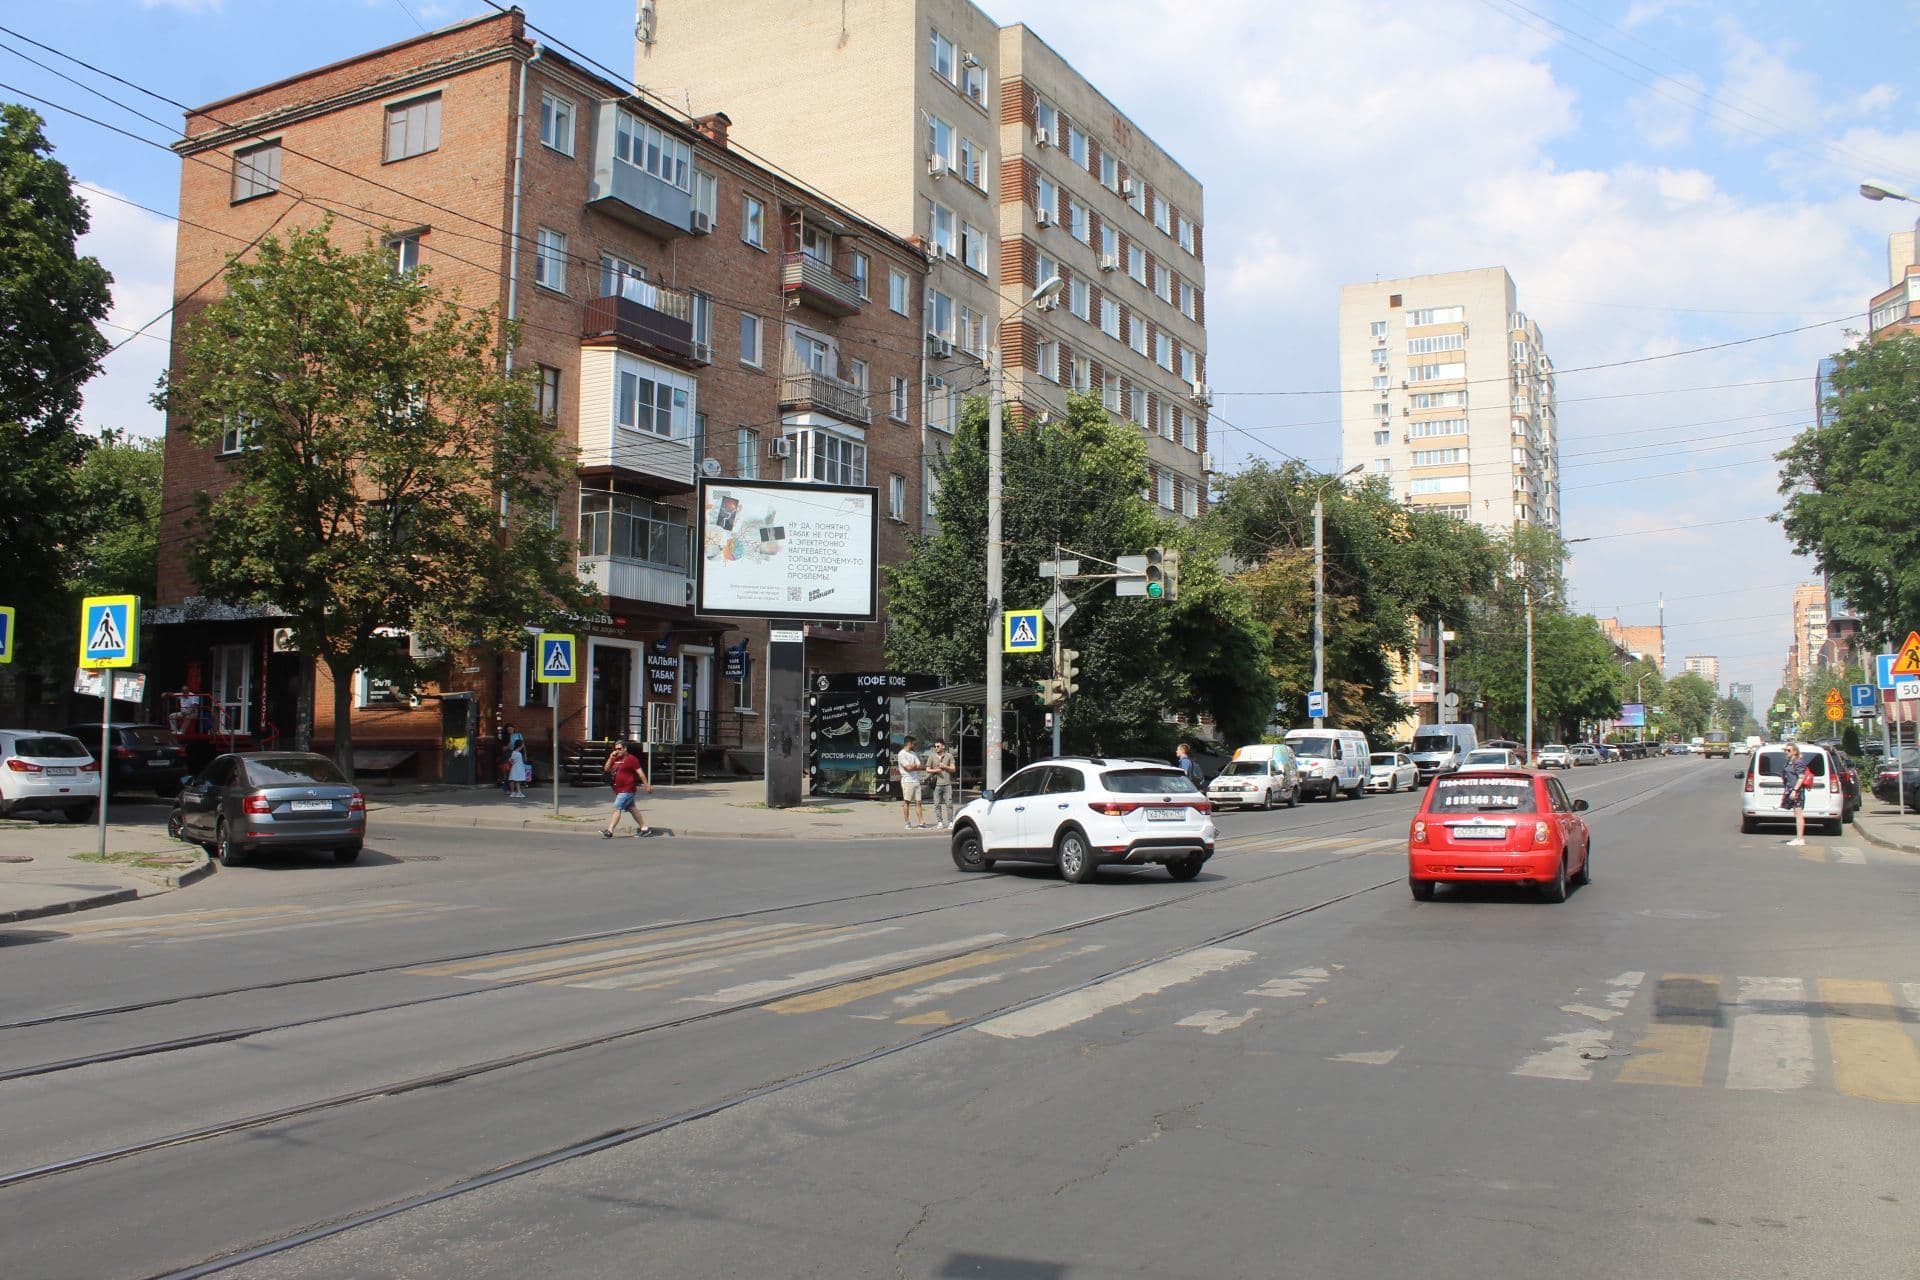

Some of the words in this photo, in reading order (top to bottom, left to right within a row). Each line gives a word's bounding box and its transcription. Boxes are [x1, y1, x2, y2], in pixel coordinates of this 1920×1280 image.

[788, 521, 797, 529] НУ
[796, 539, 845, 548] ЭЛЕКТРОННО
[787, 555, 819, 563] ТОЛЬКО
[821, 557, 864, 566] ПОЧЕМУ-ТО
[787, 563, 794, 571] С
[796, 564, 838, 572] СОСУДАМИ
[648, 655, 678, 667] КАЛЬЯН
[650, 669, 675, 680] ТАБАК
[857, 676, 886, 686] КОФЕ
[888, 676, 907, 686] КОФЕ
[653, 683, 672, 694] VAPE
[1903, 684, 1919, 695] 50
[1829, 708, 1839, 717] 40
[821, 752, 875, 760] РОСТОВ-НА-ДОНУ
[1445, 797, 1452, 806] 8
